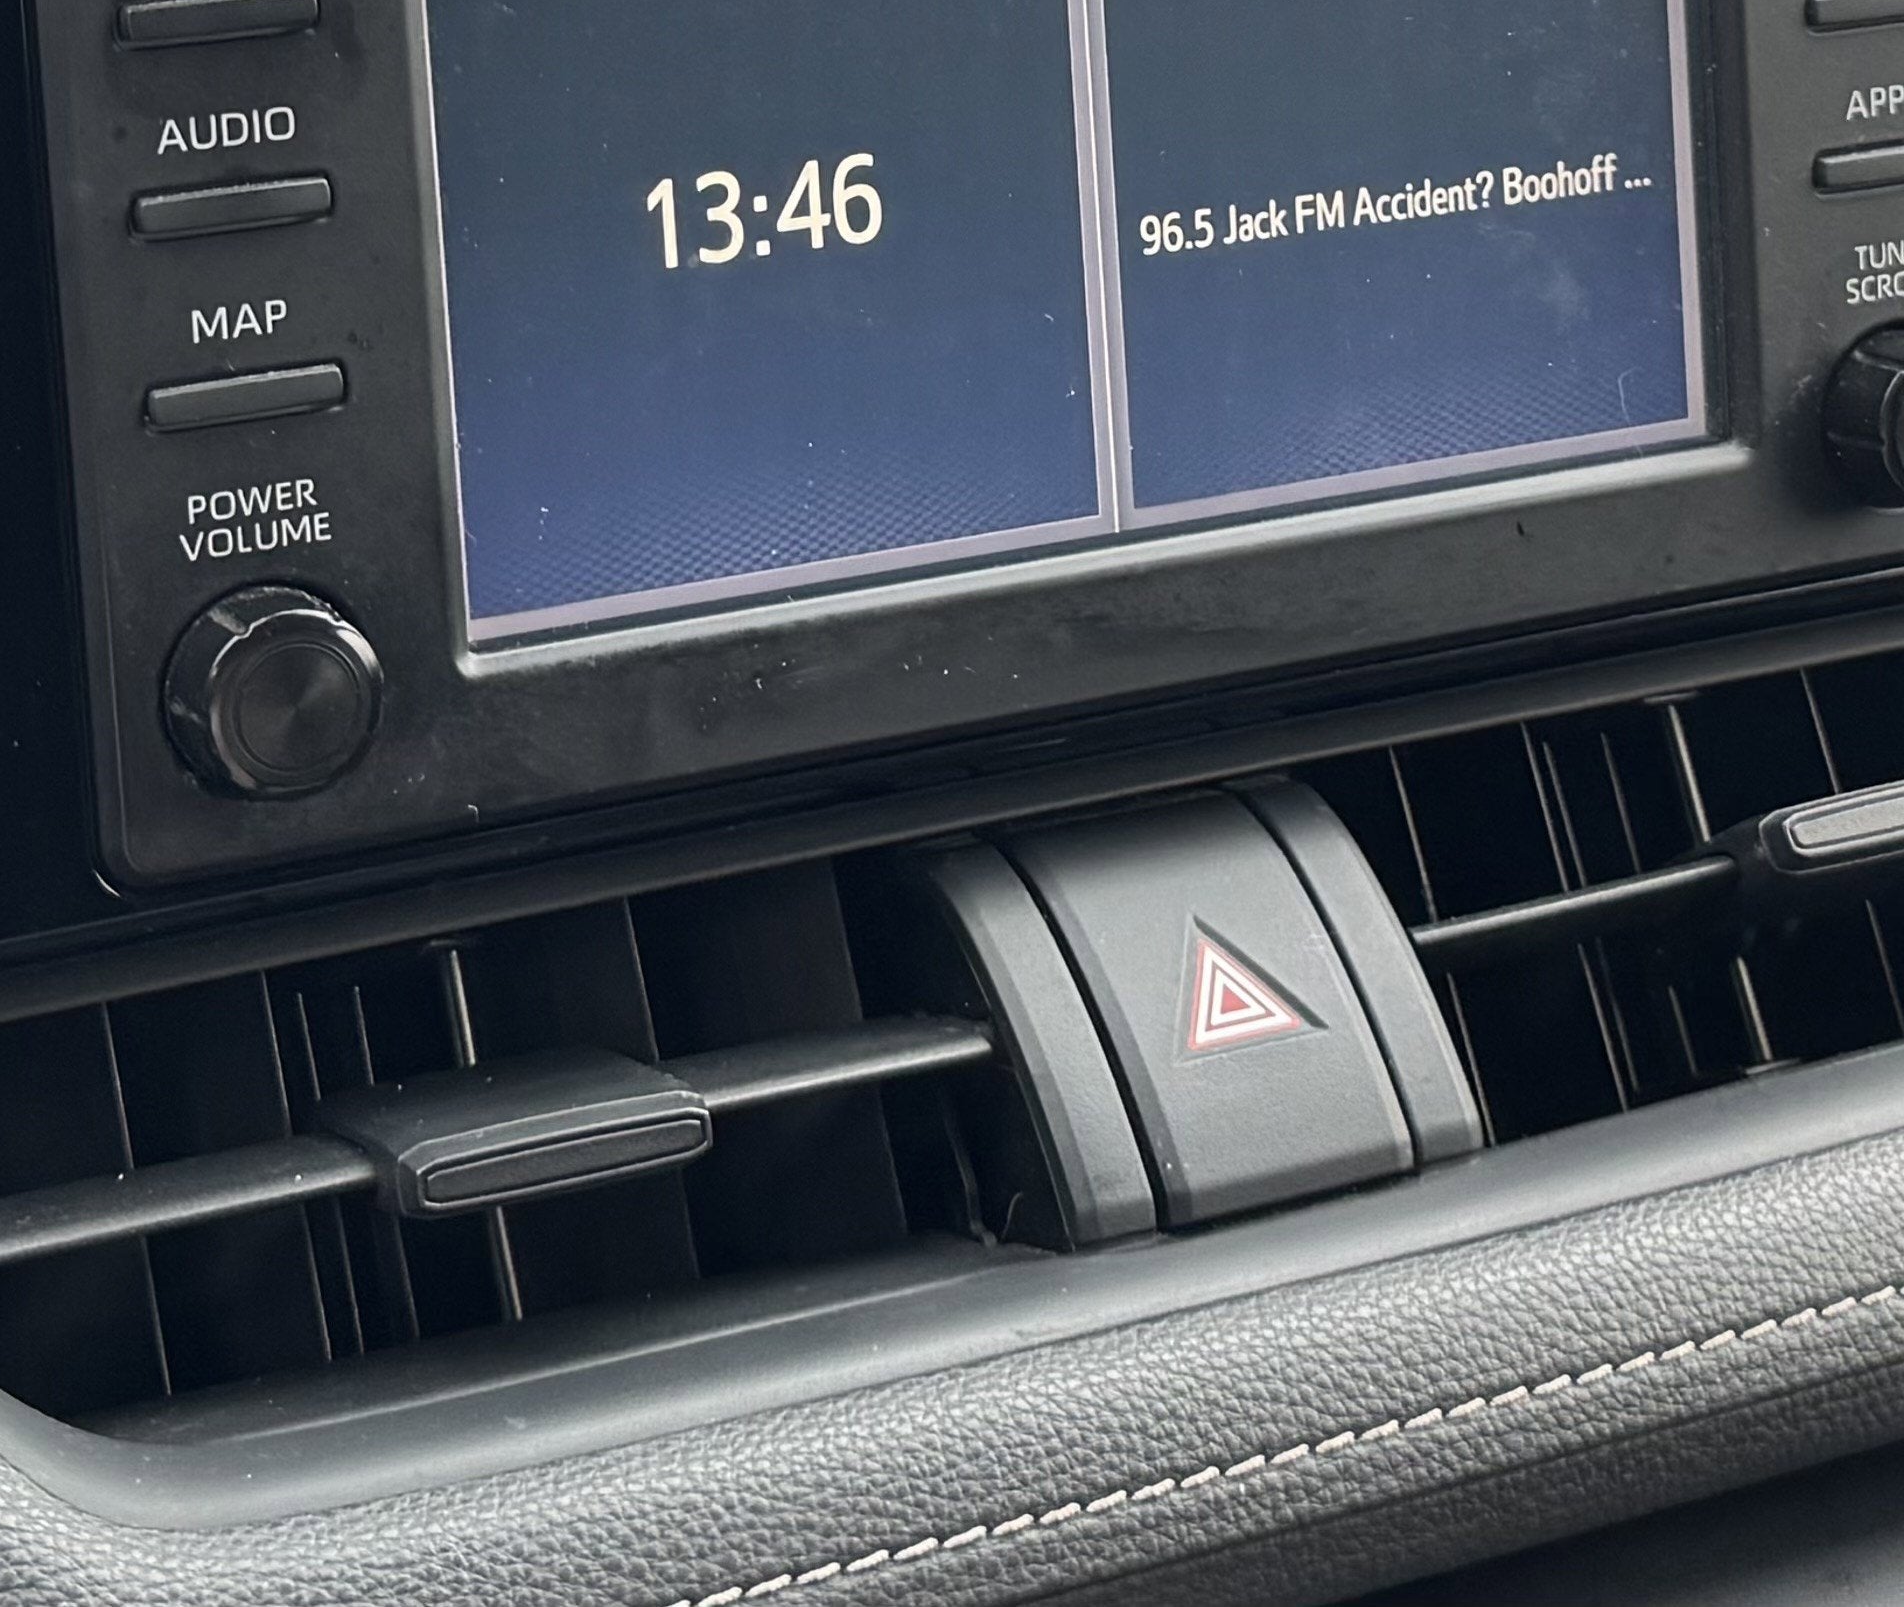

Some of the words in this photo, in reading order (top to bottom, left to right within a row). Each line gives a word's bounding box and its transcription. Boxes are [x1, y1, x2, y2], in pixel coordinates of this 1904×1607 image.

[157, 106, 296, 156] AUDIO
[646, 152, 883, 269] 13:46
[1139, 207, 1215, 257] 96.5
[1222, 199, 1290, 245] Jack
[1295, 190, 1346, 235] FM
[1352, 169, 1494, 227] Accident?
[1501, 152, 1618, 207] Boohoff
[190, 299, 288, 344] MAP
[187, 477, 318, 525] POWER
[179, 511, 332, 562] VOLUME
